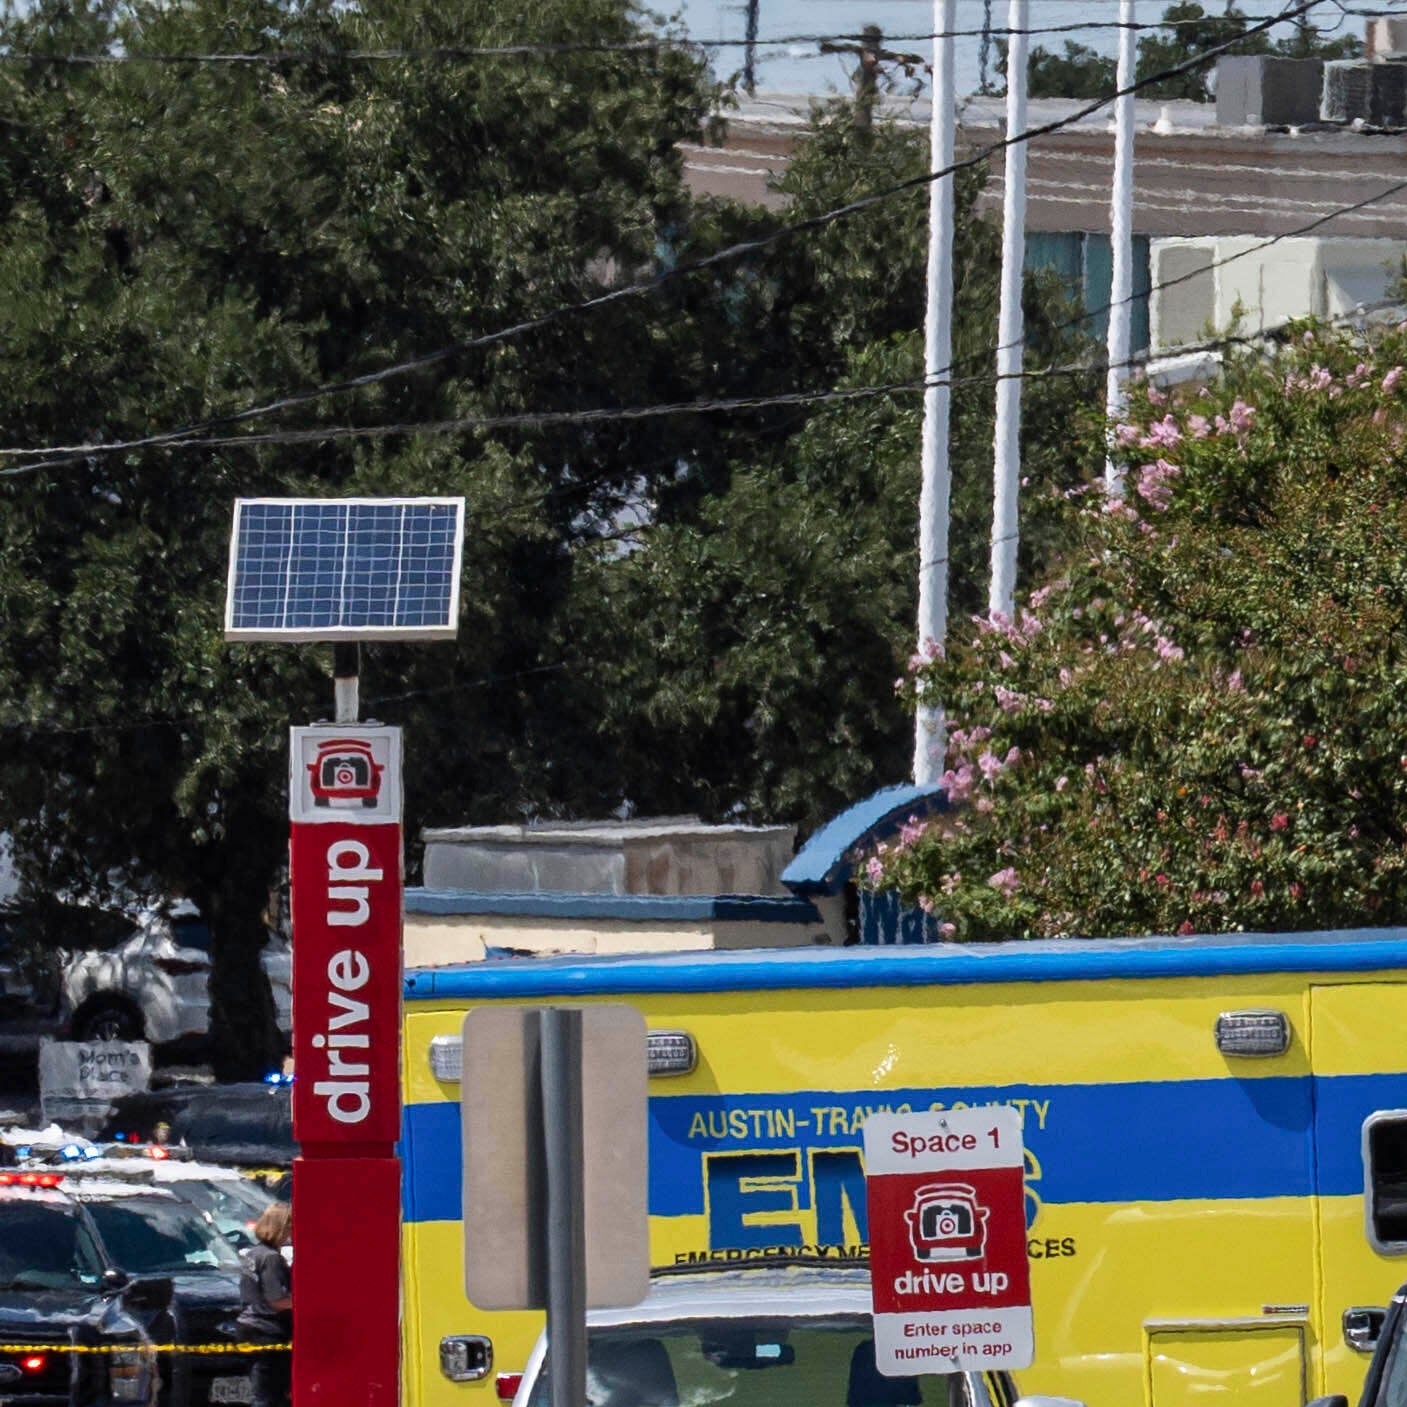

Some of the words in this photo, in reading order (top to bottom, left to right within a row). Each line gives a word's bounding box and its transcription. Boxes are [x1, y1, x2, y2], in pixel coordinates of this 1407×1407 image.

[326, 839, 383, 926] up
[312, 950, 371, 1123] drive
[892, 1131, 976, 1158] Space
[988, 1127, 1000, 1149] 1
[894, 1268, 965, 1294] drive
[972, 1272, 1009, 1295] up
[904, 1322, 948, 1337] Enter
[952, 1320, 1002, 1336] space
[895, 1345, 957, 1360] number
[963, 1342, 977, 1355] in
[983, 1342, 1012, 1356] app
